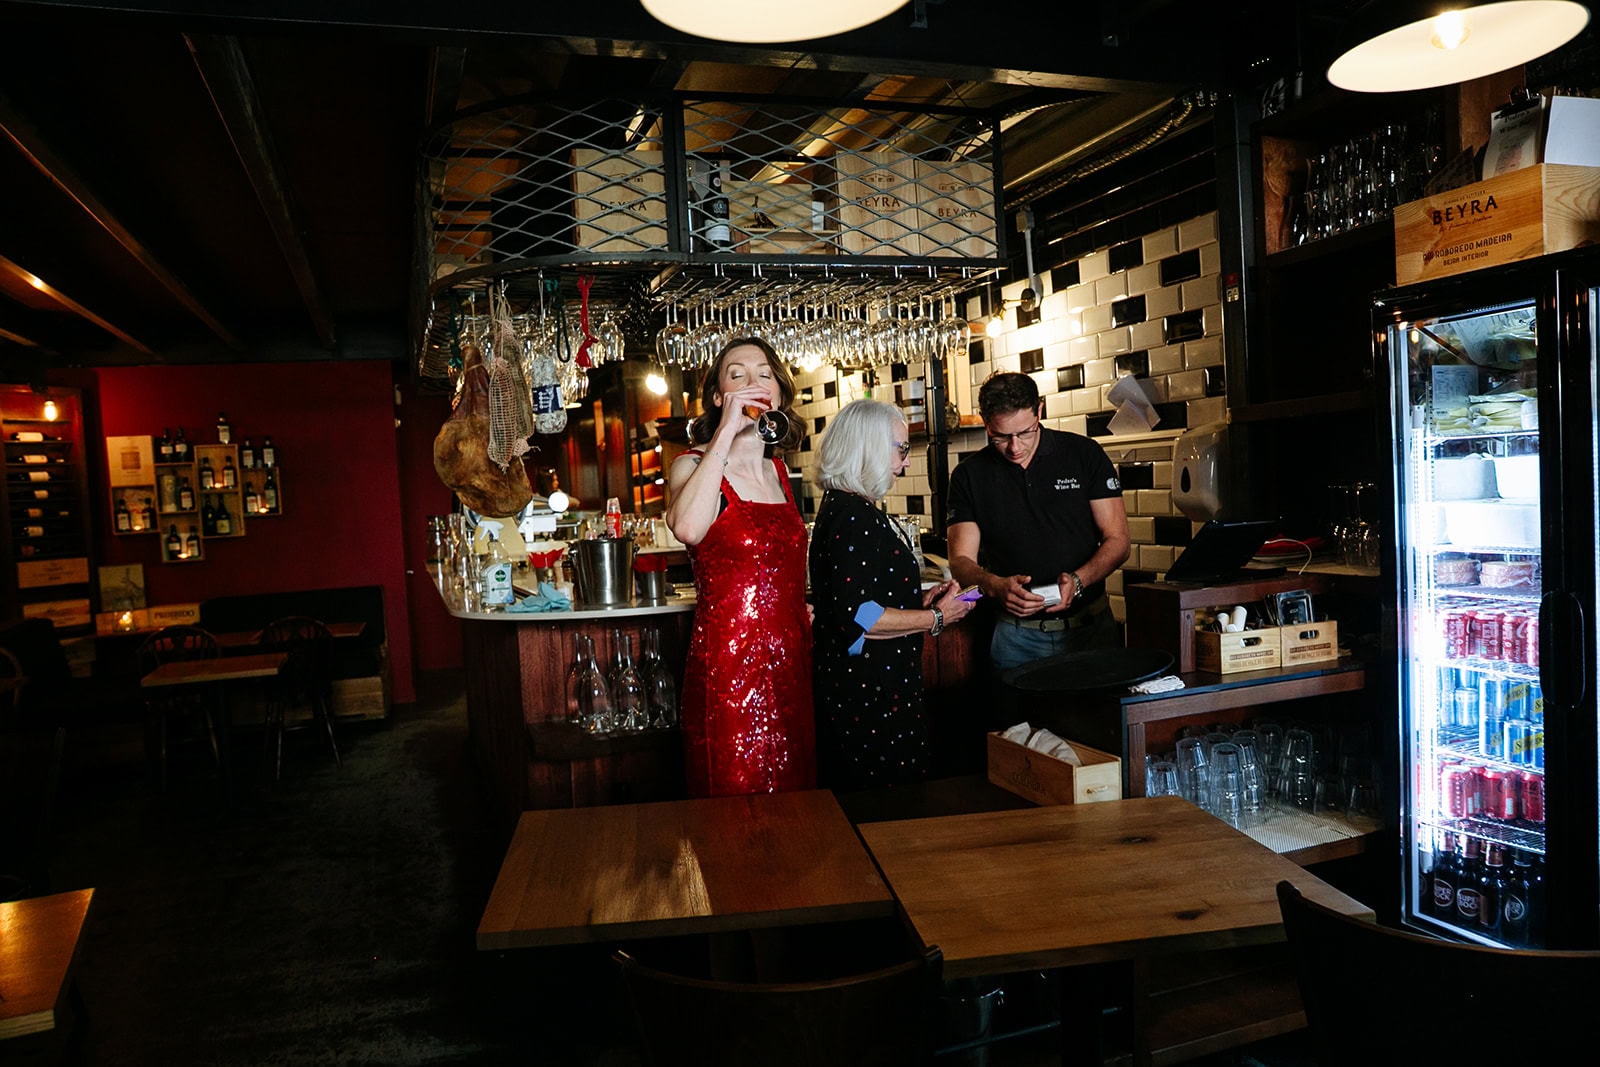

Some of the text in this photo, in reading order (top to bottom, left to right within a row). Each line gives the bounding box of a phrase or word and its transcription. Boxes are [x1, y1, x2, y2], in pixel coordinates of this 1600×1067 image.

[938, 208, 978, 218] BEYRA
[1433, 196, 1498, 225] BEYRA
[1435, 242, 1474, 258] ROBOREDO
[1475, 233, 1512, 249] MADEIRA
[1461, 250, 1489, 262] INTERIOR
